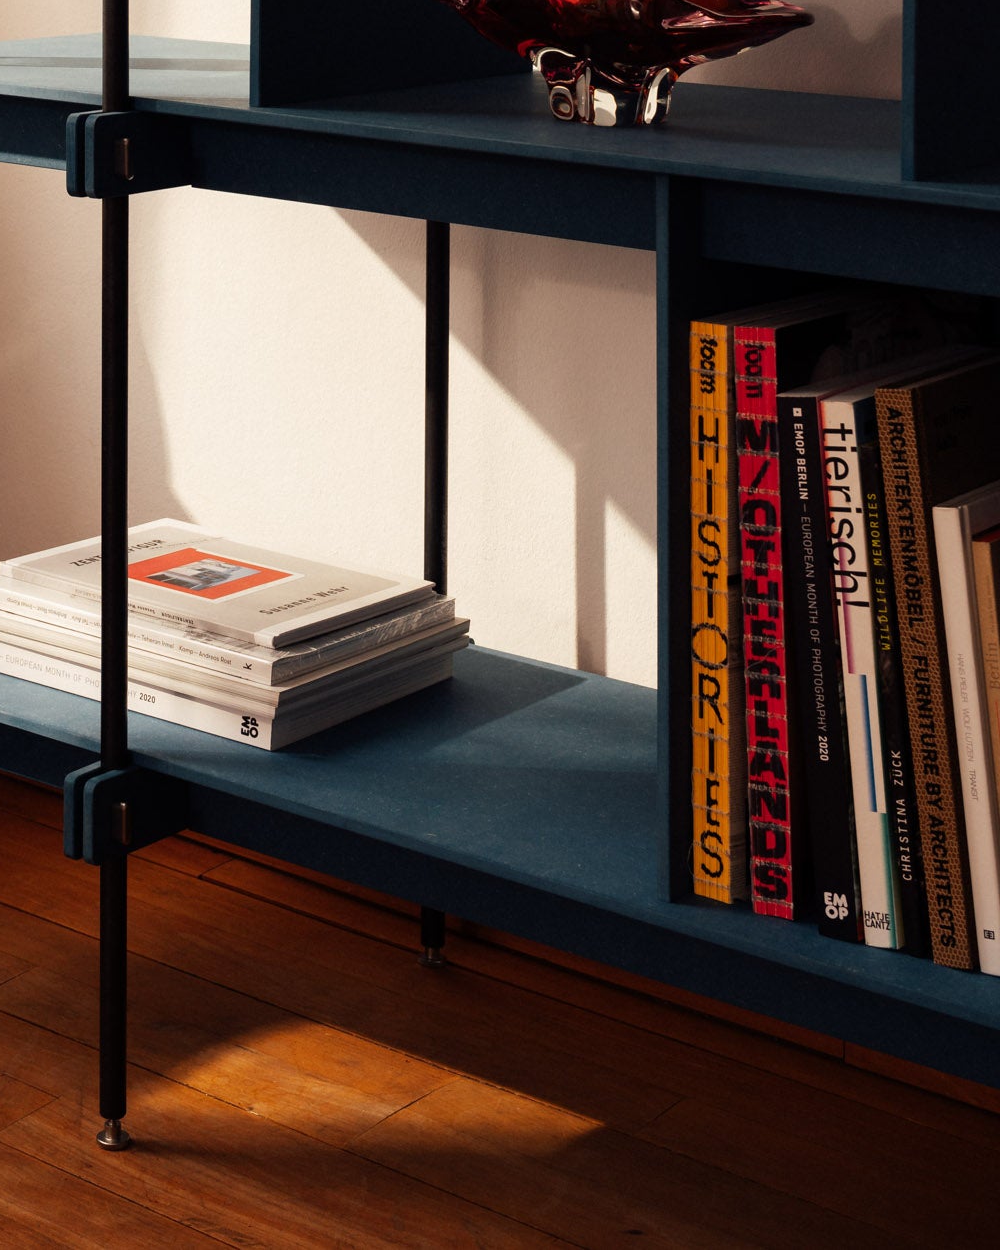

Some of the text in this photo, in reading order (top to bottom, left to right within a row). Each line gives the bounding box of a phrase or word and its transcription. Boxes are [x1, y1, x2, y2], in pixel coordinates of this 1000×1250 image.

[700, 338, 718, 395] foam
[745, 343, 765, 398] foam
[794, 423, 805, 456] EMOP
[796, 458, 808, 500] BERLIN
[823, 423, 870, 607] tierisch!
[885, 405, 925, 628] ARCHITEKTENMÖBEL
[801, 516, 815, 579] EUROPEAN
[867, 493, 891, 650] WILDLIFE MEMORIES
[259, 597, 316, 615] Susanne
[313, 586, 350, 598] Wehr
[807, 583, 819, 624] MONTH
[199, 651, 220, 662] Andreas
[220, 656, 232, 665] Rost
[691, 415, 728, 878] HISTORIES
[810, 629, 821, 644] OF
[5, 654, 43, 672] EUROPEAN
[45, 666, 71, 680] MONTH
[72, 673, 83, 683] OF
[139, 692, 156, 704] 2020
[986, 642, 1000, 690] Berlin
[812, 648, 827, 732] PHOTOGRAPHY
[911, 655, 939, 776] FURNITURE
[818, 735, 829, 762] 2020
[925, 781, 943, 811] BY
[968, 769, 979, 801] TRANSIT
[895, 798, 913, 881] CHRISTINA
[823, 891, 848, 908] EM
[928, 814, 957, 949] ARCHITECTS
[825, 905, 849, 920] OP
[864, 910, 891, 922] HATJE
[864, 919, 892, 931] CANTZ
